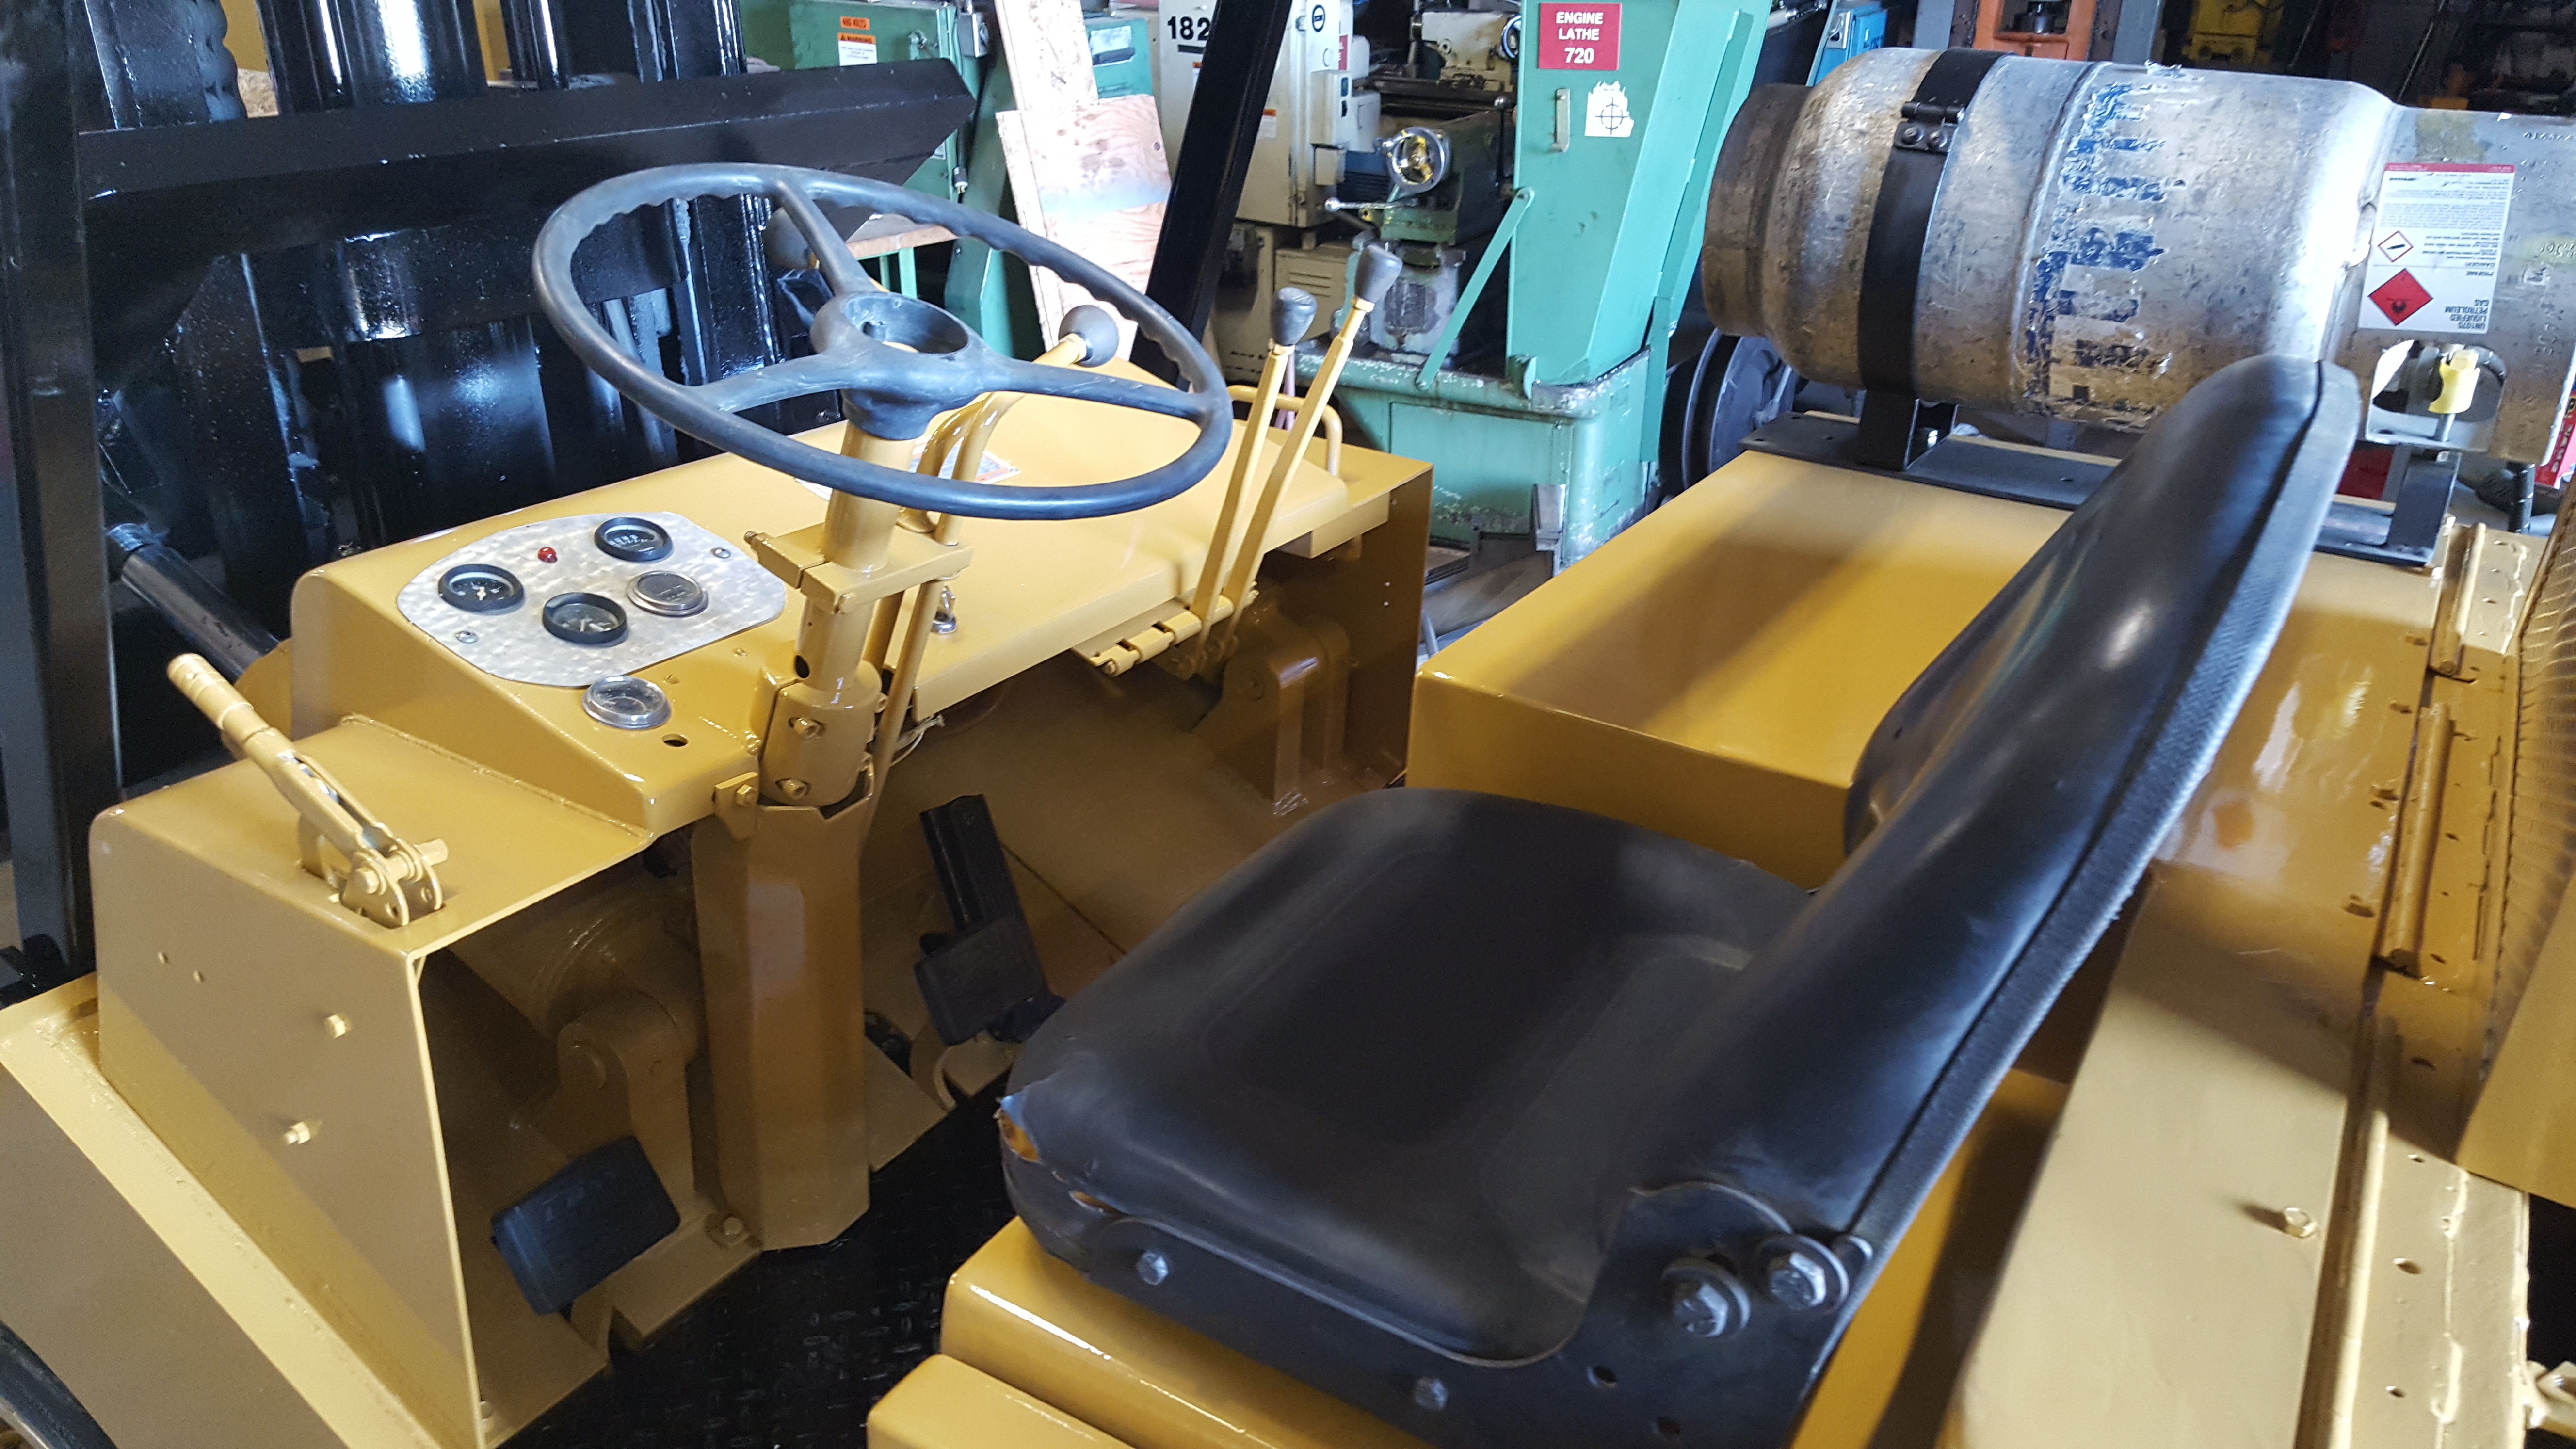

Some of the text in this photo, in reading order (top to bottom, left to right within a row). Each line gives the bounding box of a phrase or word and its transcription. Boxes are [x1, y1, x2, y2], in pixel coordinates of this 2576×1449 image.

[1555, 12, 1604, 25] ENGINE
[1167, 16, 1210, 41] 182
[1558, 27, 1600, 41] LATHE
[847, 35, 872, 44] WARNING
[1564, 47, 1595, 64] 720
[2474, 299, 2490, 307] GAS
[2444, 306, 2489, 314] PETROLEUM
